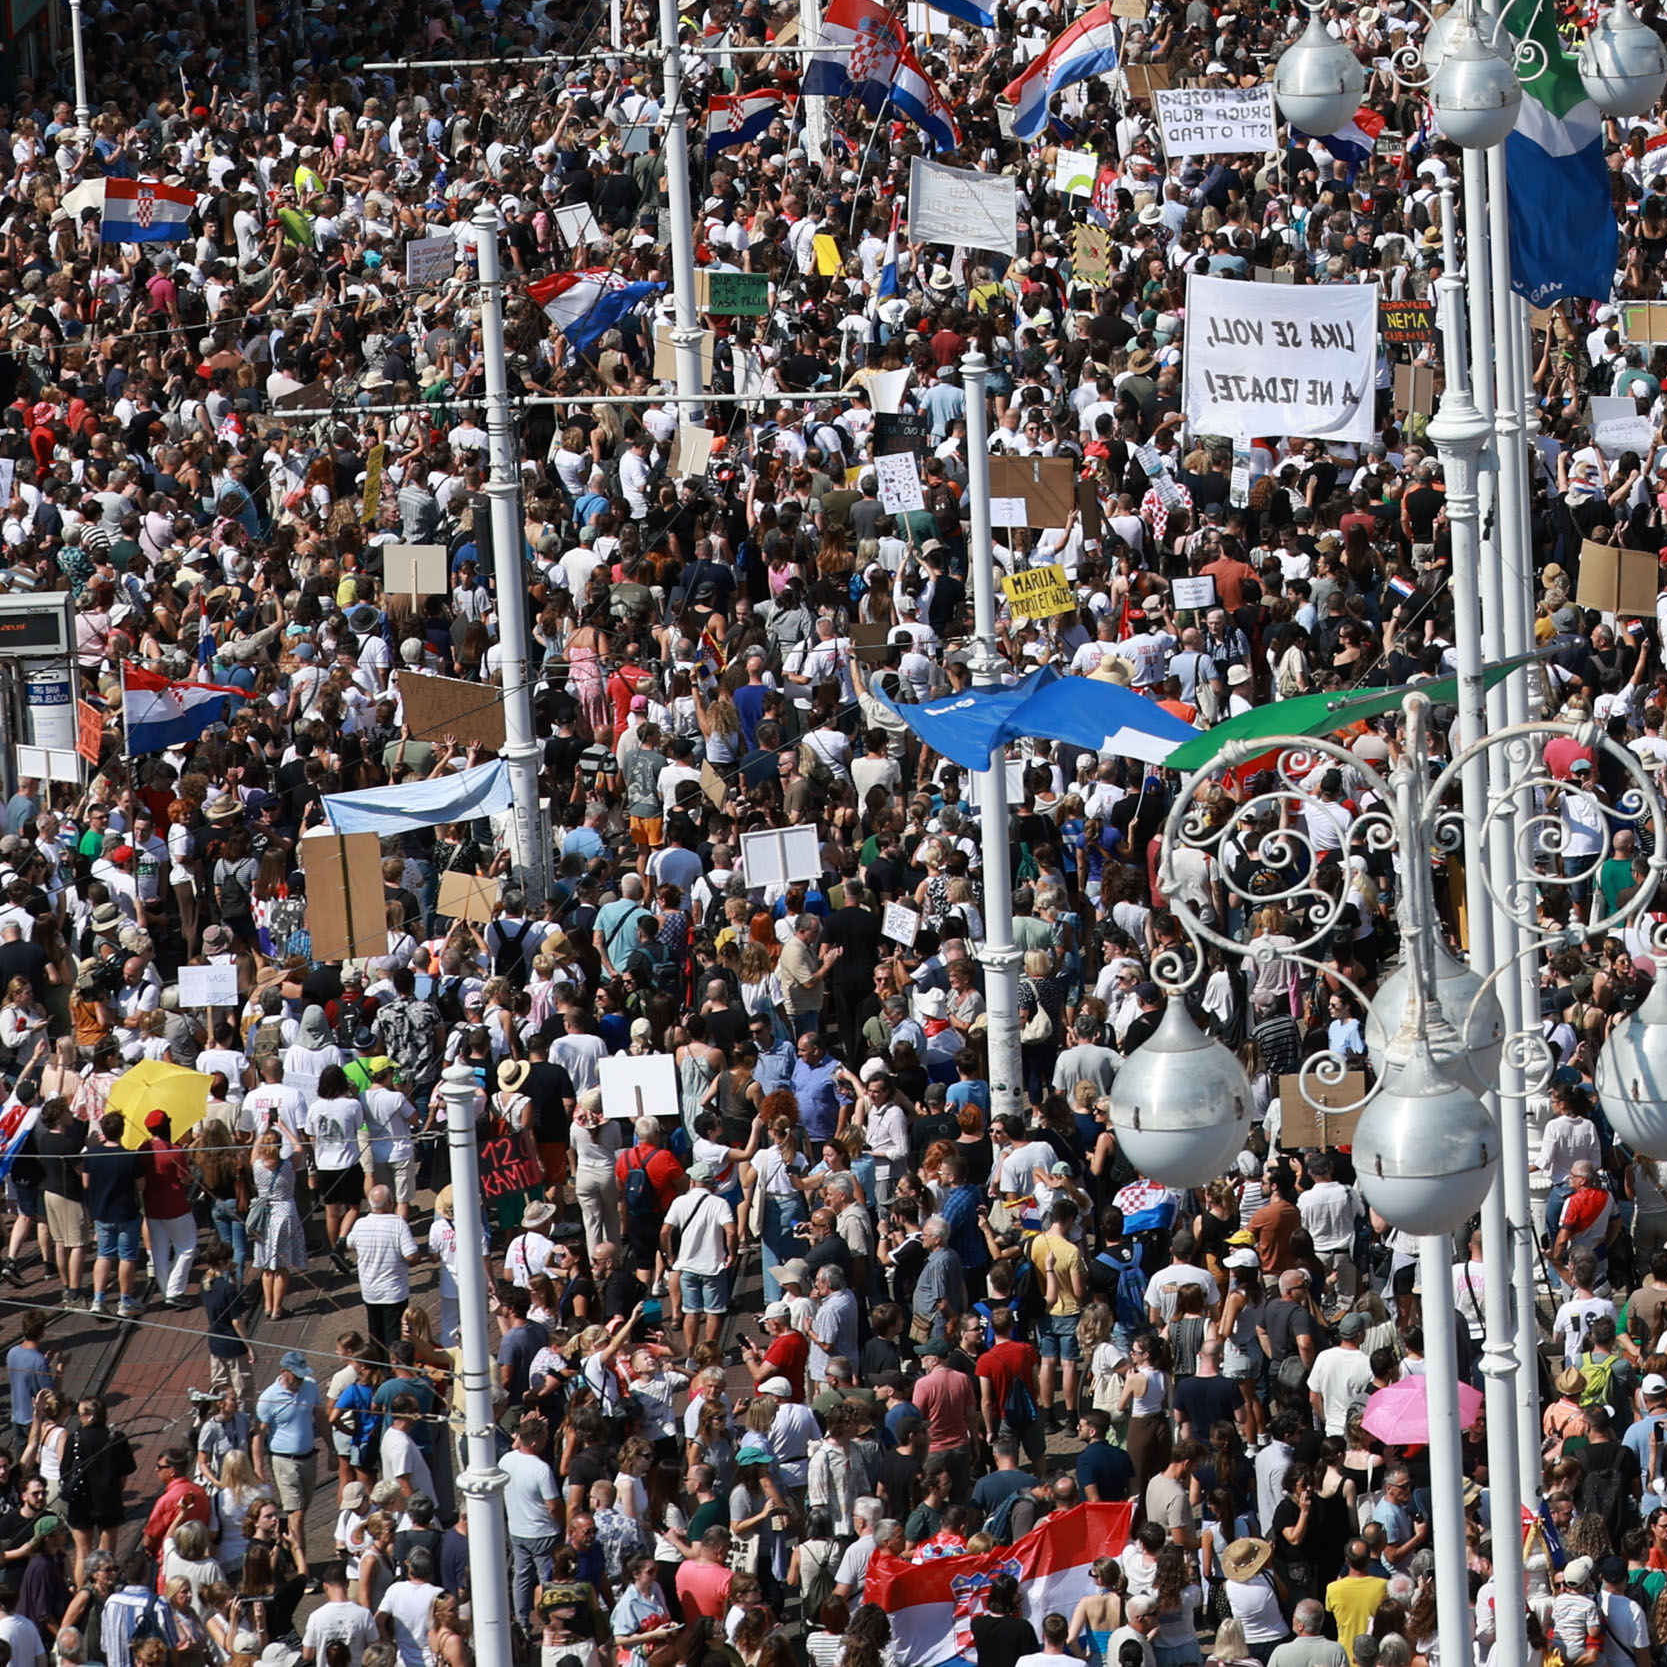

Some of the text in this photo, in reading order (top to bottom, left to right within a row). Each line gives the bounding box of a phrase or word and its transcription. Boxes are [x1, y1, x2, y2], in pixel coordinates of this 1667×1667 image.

[1512, 280, 1562, 303] VGAN
[1386, 312, 1429, 329] NEMA
[1010, 591, 1047, 614] PRIORITET
[32, 686, 61, 695] TRG BANA
